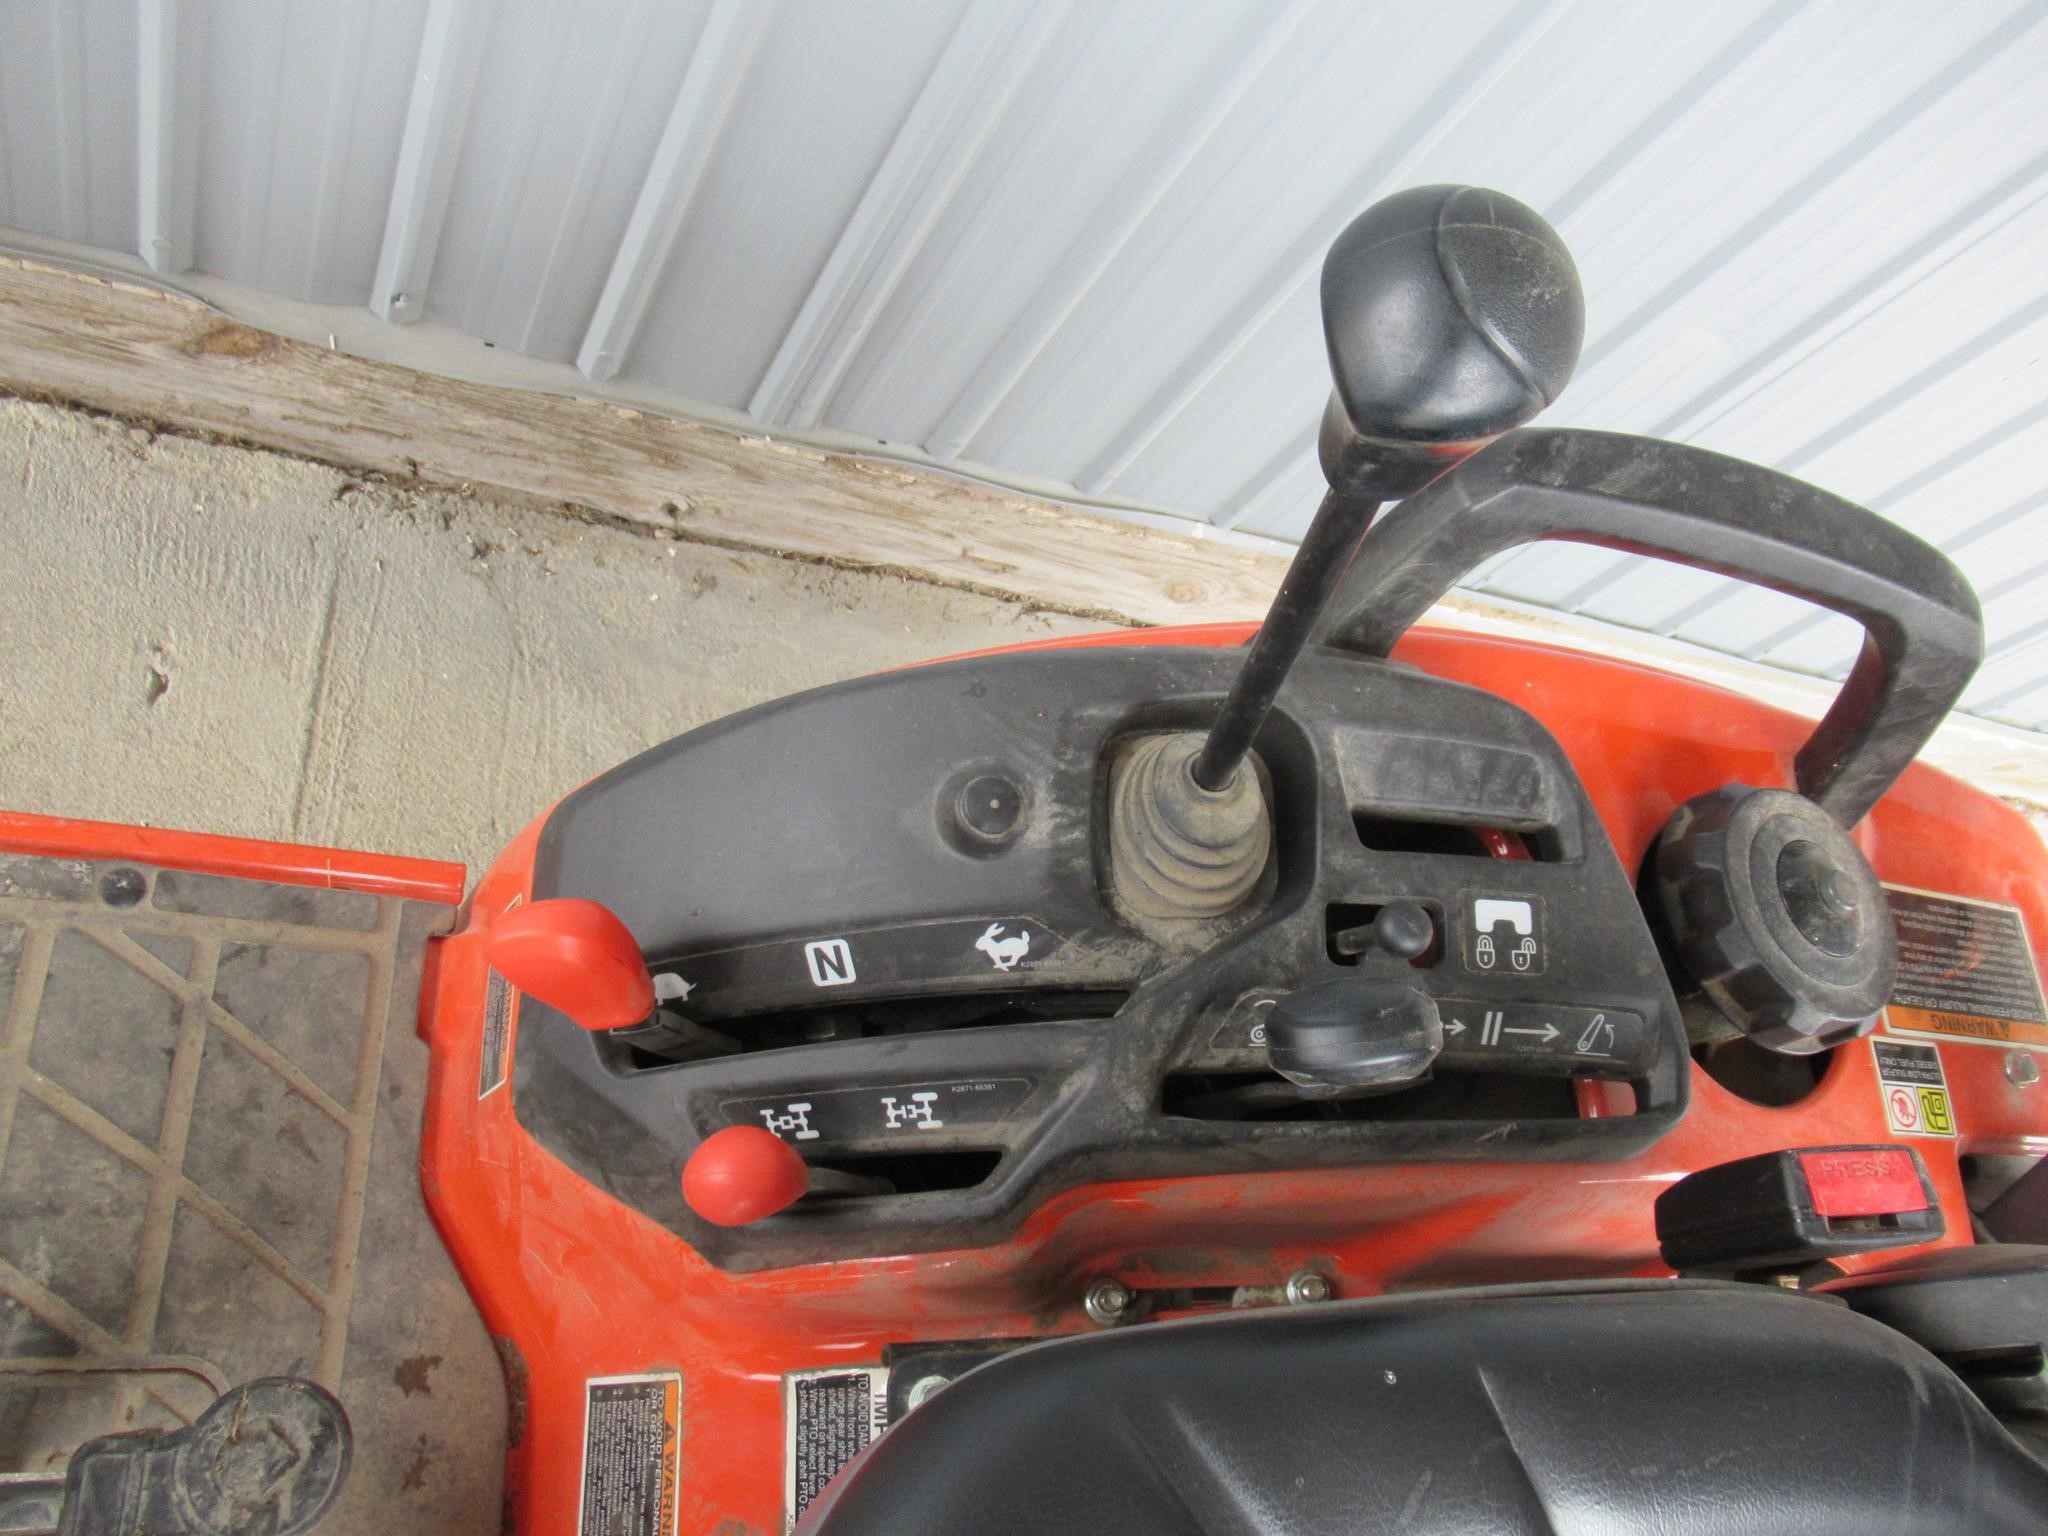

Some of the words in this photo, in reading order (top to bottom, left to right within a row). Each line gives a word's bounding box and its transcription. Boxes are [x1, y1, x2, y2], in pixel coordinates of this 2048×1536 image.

[813, 944, 849, 981] N
[1929, 1014, 1997, 1037] WARNING
[1820, 1159, 1892, 1178] PRESS
[858, 1376, 869, 1390] TO
[651, 1388, 658, 1409] OR
[657, 1388, 665, 1408] TO
[808, 1389, 818, 1417] When
[818, 1388, 828, 1430] rearward
[836, 1387, 846, 1414] range
[848, 1387, 857, 1415] When
[857, 1391, 869, 1422] AVOID
[656, 1411, 664, 1455] AVOID
[808, 1418, 819, 1441] PTO
[818, 1431, 826, 1444] on
[836, 1416, 846, 1438] gear
[847, 1416, 856, 1438] front
[649, 1413, 657, 1465] DEATH:
[797, 1424, 809, 1458] slightly
[826, 1424, 837, 1457] slightly
[808, 1442, 818, 1471] select
[816, 1446, 826, 1476] speed
[838, 1440, 847, 1462] shift
[799, 1459, 809, 1480] shift
[825, 1459, 836, 1480] step
[798, 1481, 809, 1504] PTO
[808, 1472, 818, 1496] lever
